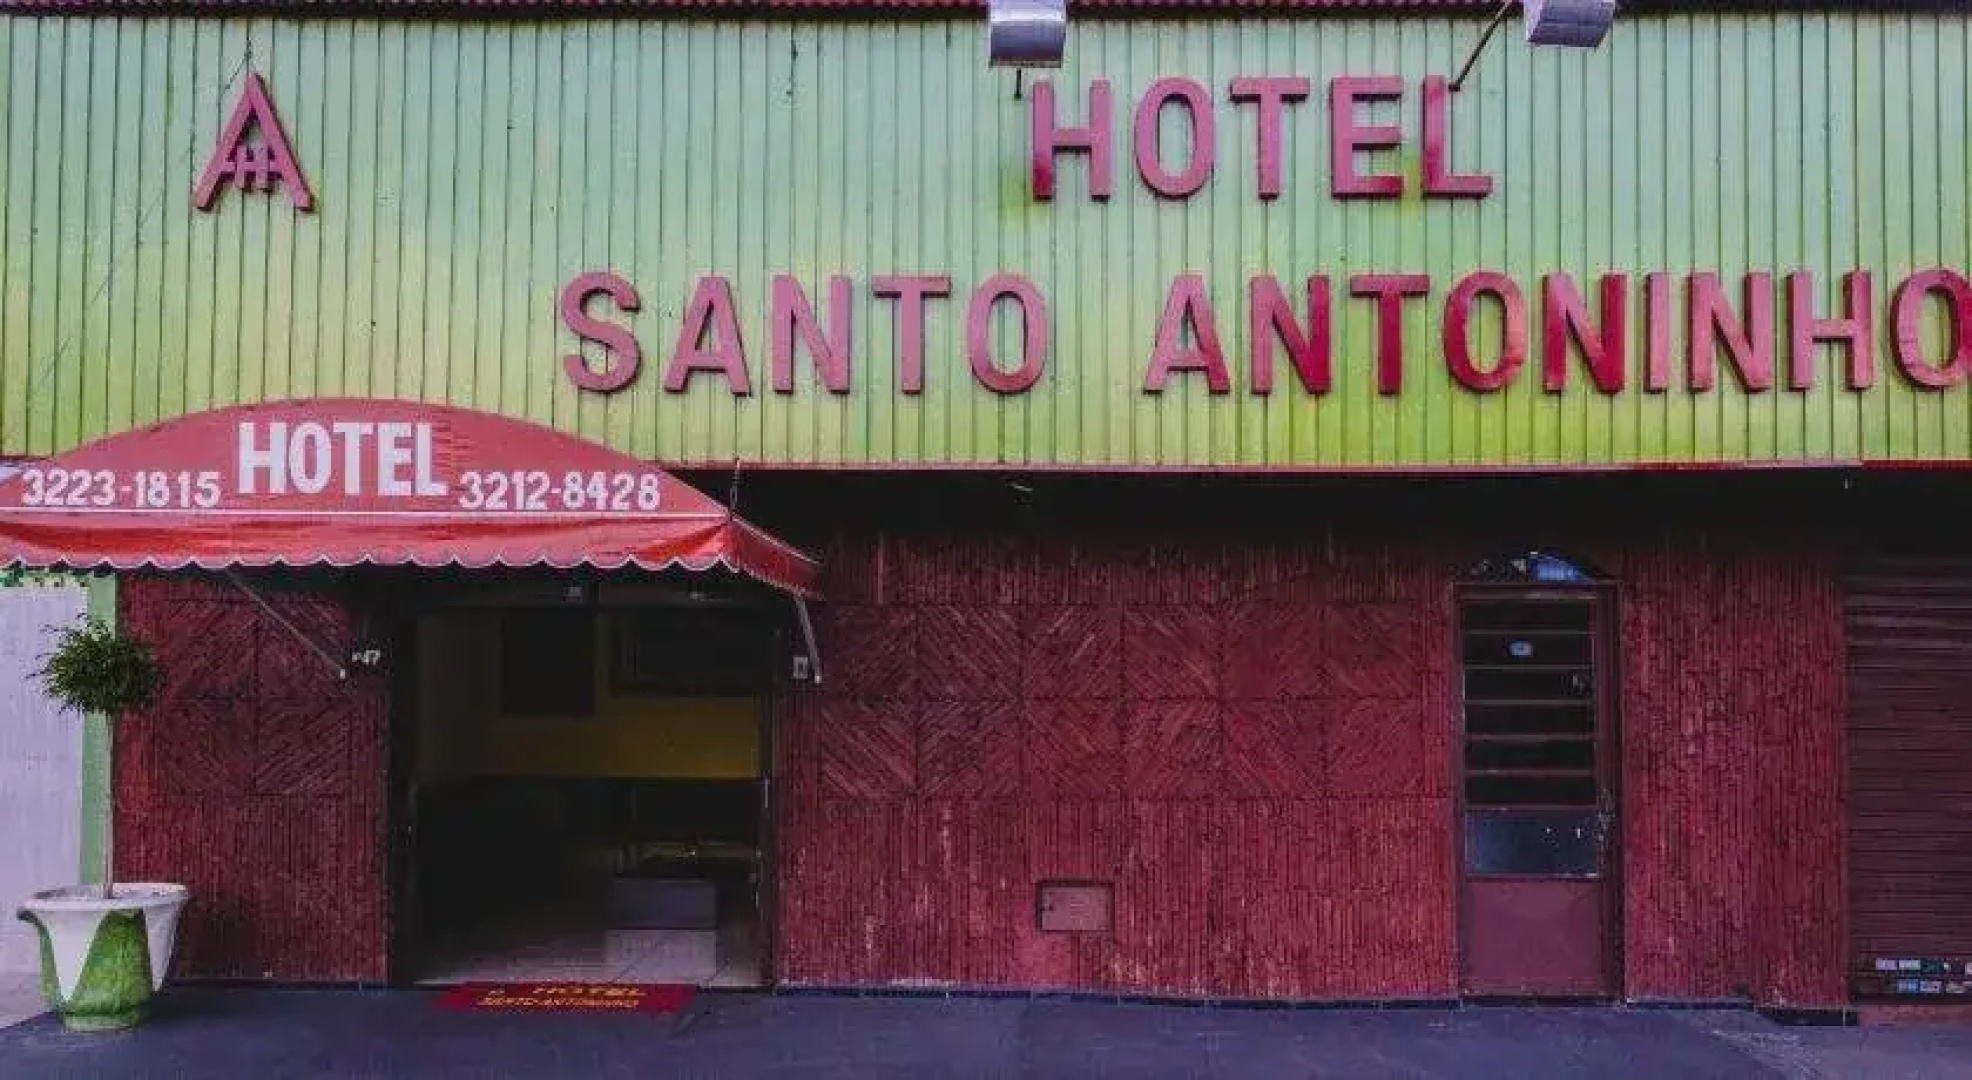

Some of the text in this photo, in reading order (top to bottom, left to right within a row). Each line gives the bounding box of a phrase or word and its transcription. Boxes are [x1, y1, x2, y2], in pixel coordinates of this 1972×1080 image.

[1032, 76, 1493, 201] HOTEL
[560, 268, 1972, 396] SANTO ANTONINHO
[22, 469, 221, 507] 3223-1815
[238, 422, 448, 496] HOTEL
[459, 471, 660, 510] 3212-8428
